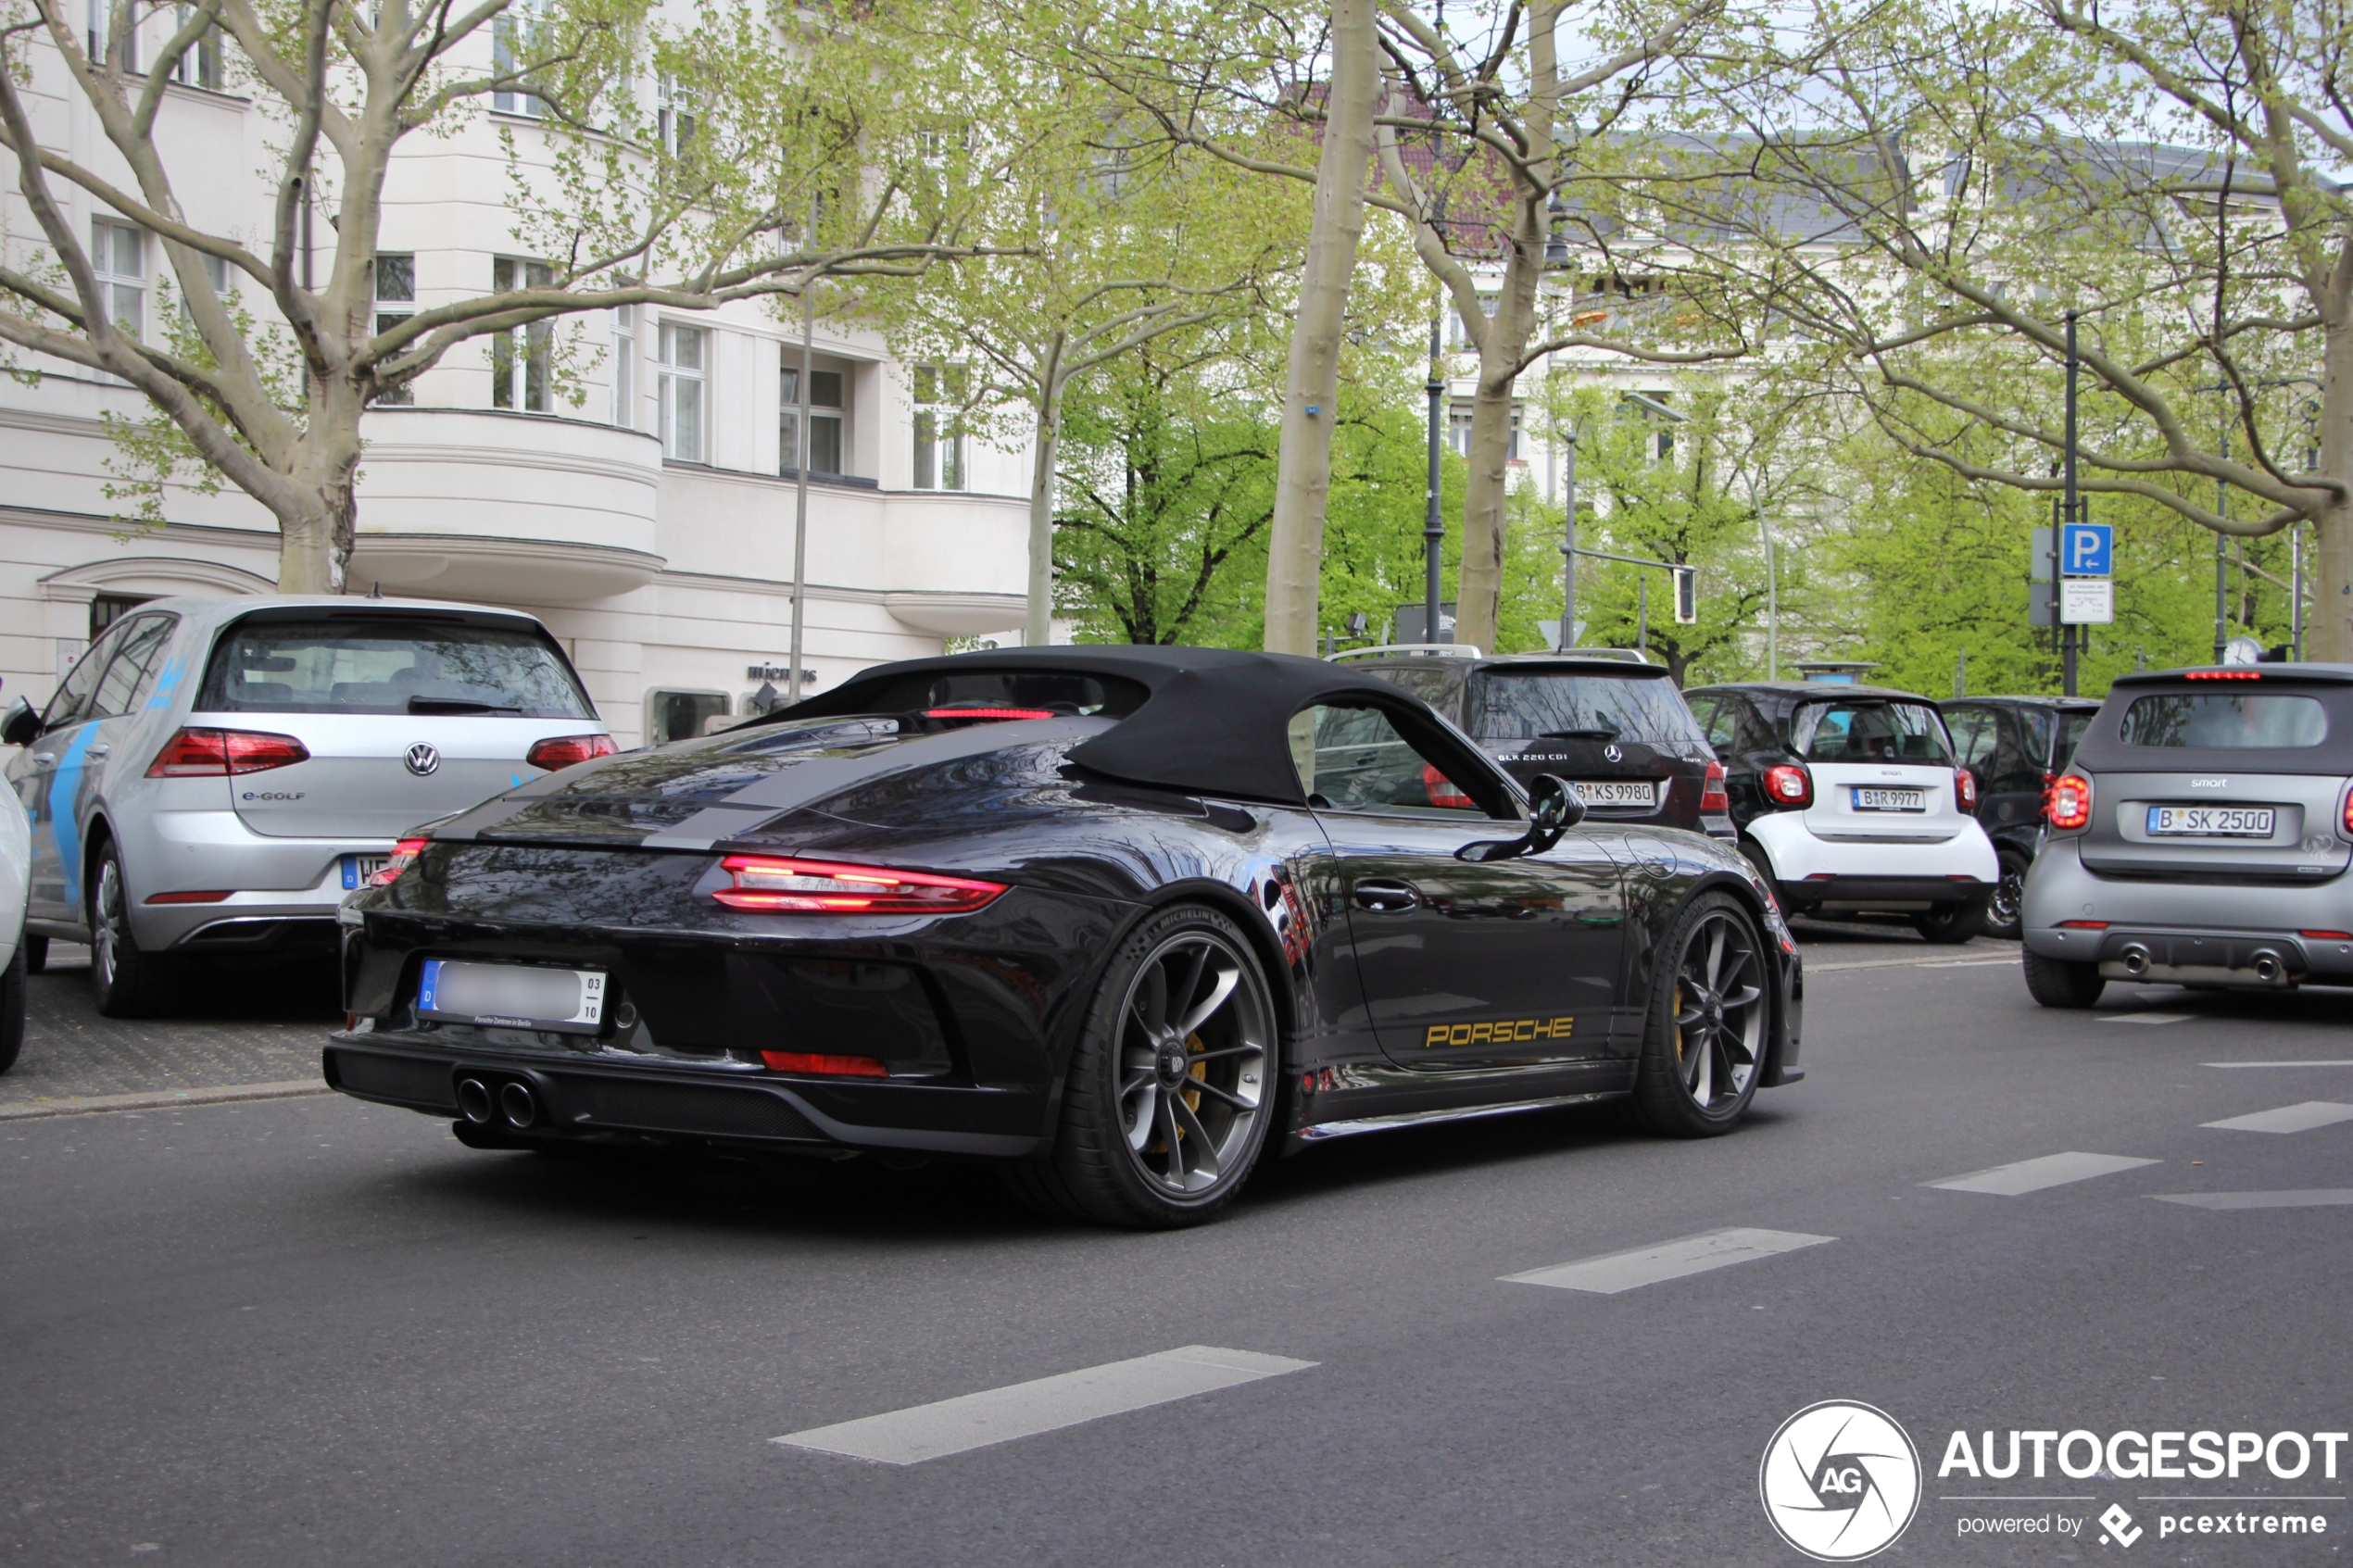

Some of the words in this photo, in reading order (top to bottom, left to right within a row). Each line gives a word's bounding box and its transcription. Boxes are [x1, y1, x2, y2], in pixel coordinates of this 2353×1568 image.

[2074, 531, 2100, 568] P
[2191, 779, 2227, 788] smart
[242, 792, 306, 801] e-GOLF
[1594, 784, 1614, 800] KS
[1617, 784, 1651, 800] 9980
[1864, 791, 1873, 805] B
[1880, 791, 1889, 805] R
[1891, 792, 1919, 806] 9977
[2159, 809, 2172, 828] B
[2186, 810, 2213, 830] SK
[2217, 811, 2270, 830] 2500
[1160, 909, 1211, 930] MICHELIN
[587, 978, 601, 990] 03
[424, 990, 432, 1002] D
[585, 1007, 598, 1019] 10
[474, 1015, 494, 1024] Porsche
[518, 1020, 532, 1028] Berlin
[1427, 1017, 1573, 1047] PORSCHE
